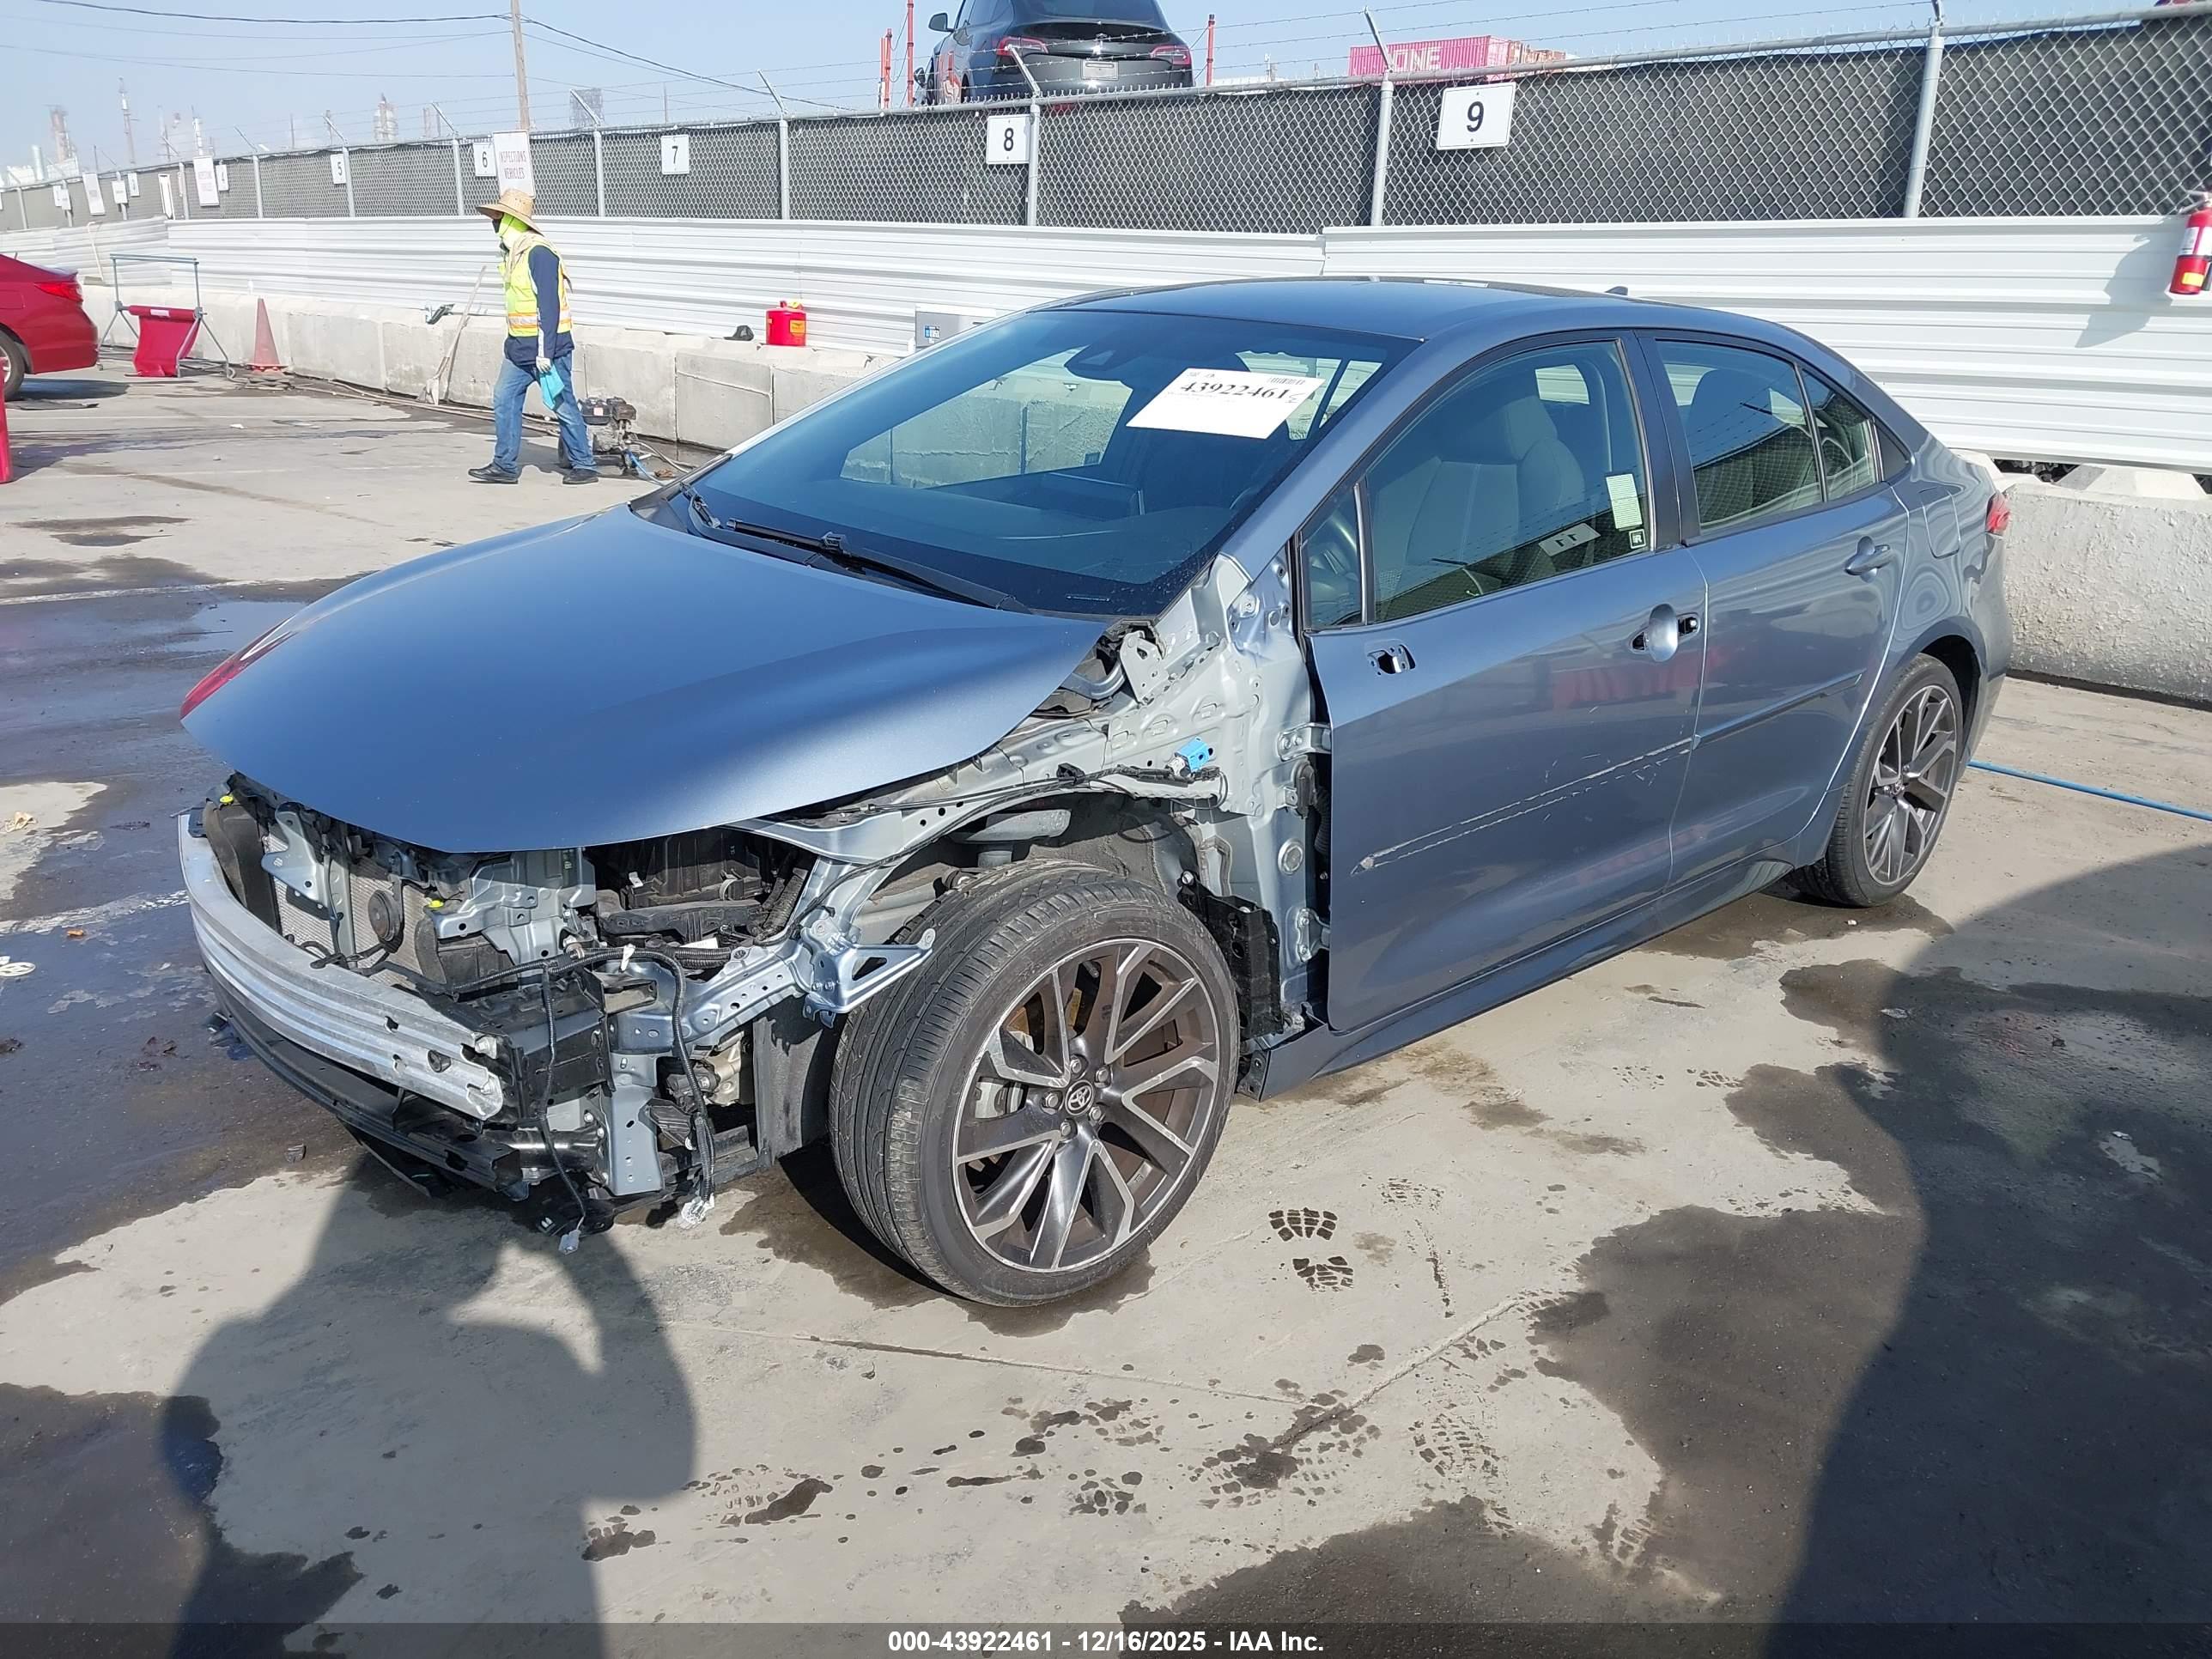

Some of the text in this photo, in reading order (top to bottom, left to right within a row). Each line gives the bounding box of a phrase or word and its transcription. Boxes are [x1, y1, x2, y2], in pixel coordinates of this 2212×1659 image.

[1394, 46, 1443, 72] ONE
[1467, 100, 1485, 133] 9
[1003, 127, 1014, 152] 8
[482, 151, 489, 168] 6
[672, 145, 678, 164] 7
[337, 161, 343, 176] 5
[1181, 381, 1290, 399] 43922461
